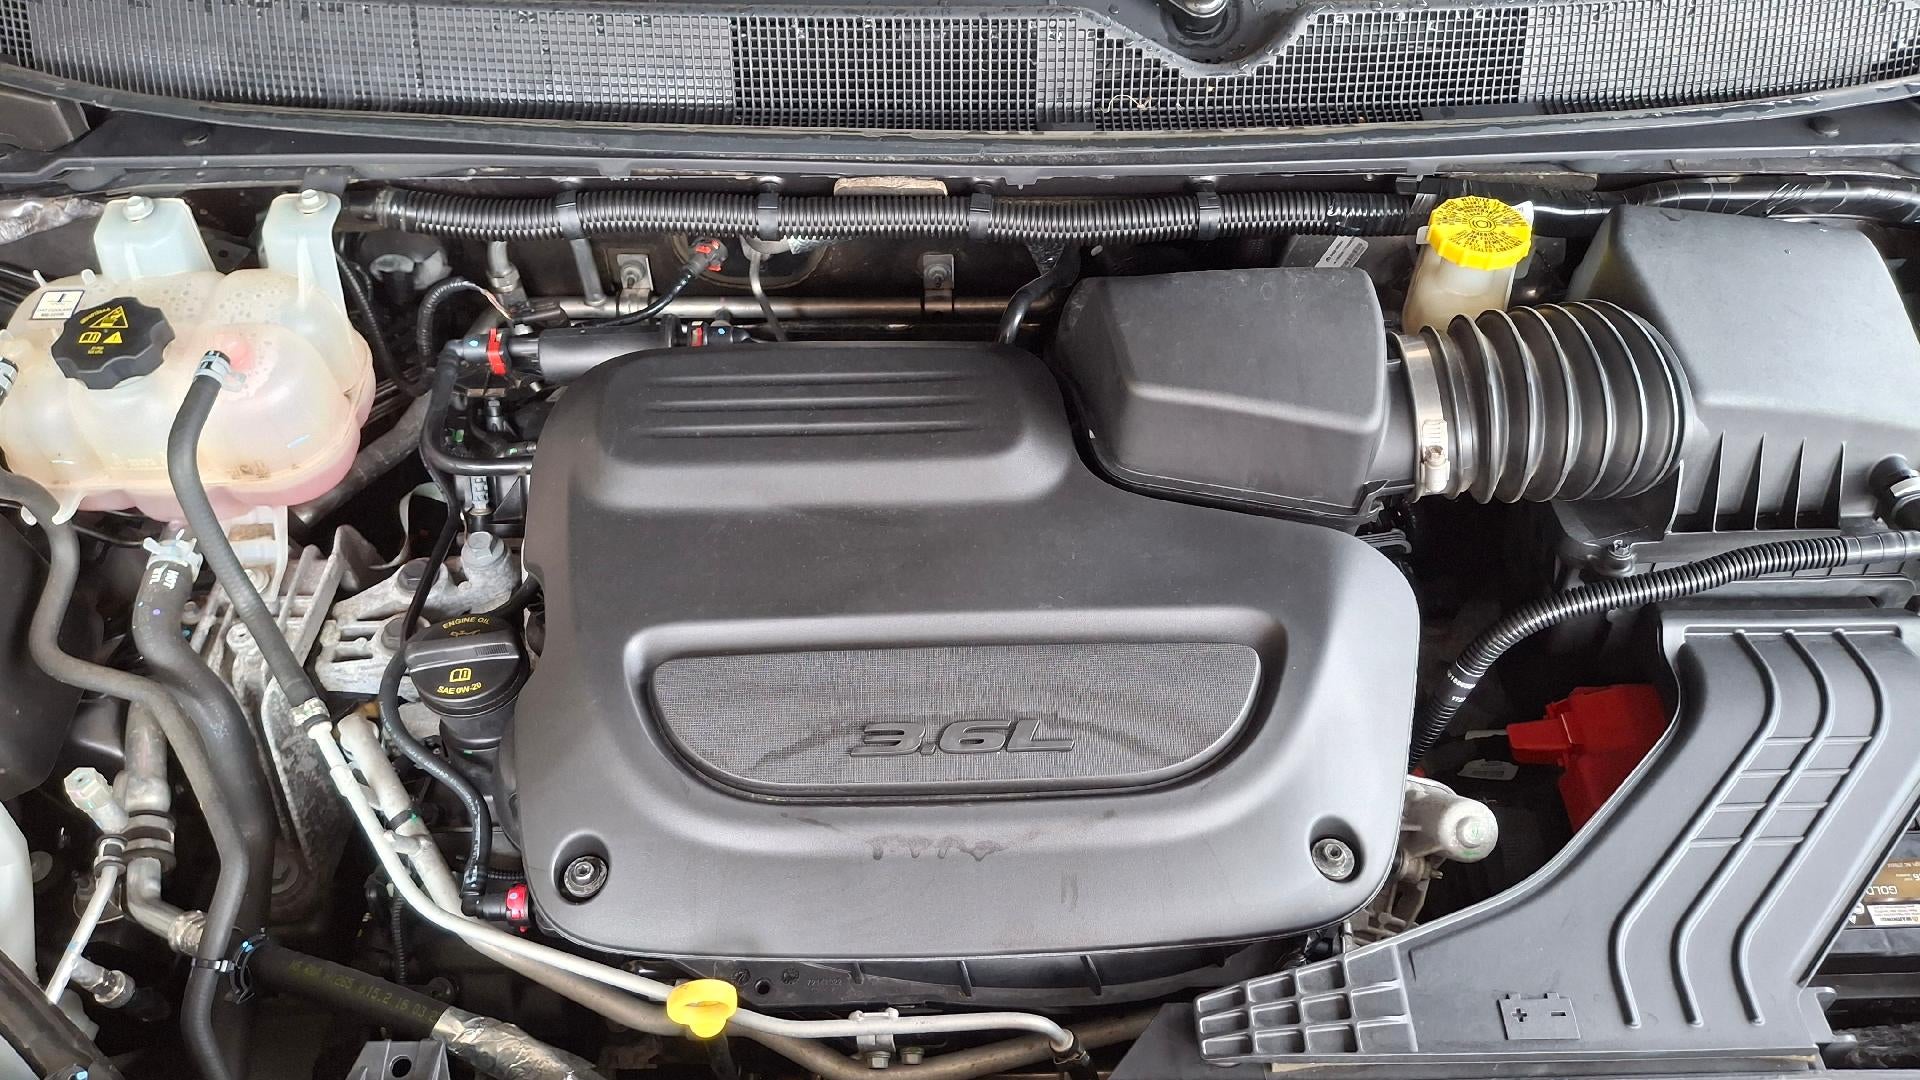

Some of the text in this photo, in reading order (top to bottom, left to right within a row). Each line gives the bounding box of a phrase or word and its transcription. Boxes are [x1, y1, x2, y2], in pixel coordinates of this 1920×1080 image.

[442, 616, 490, 629] ENGINE OIL
[437, 682, 482, 695] SAE 0W-20
[848, 718, 1076, 758] 3.6L
[1865, 885, 1898, 896] GOLD
